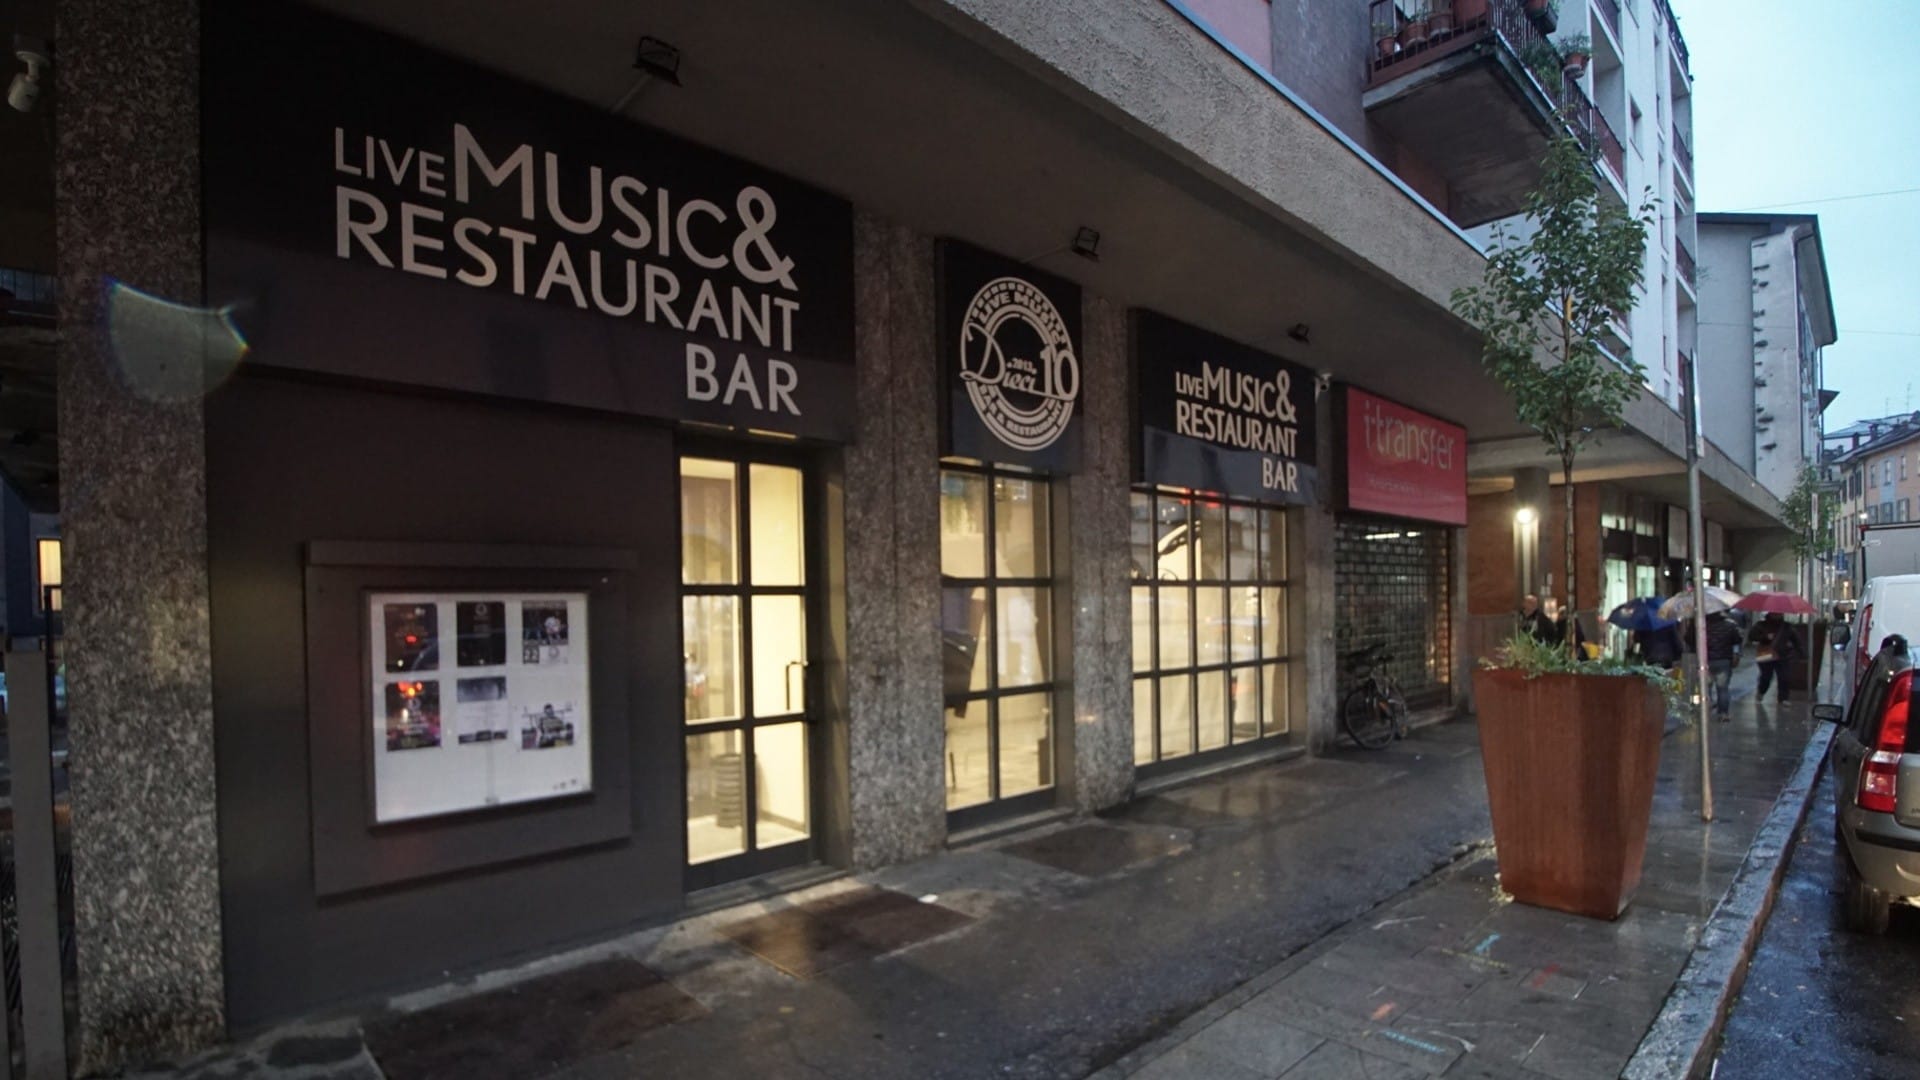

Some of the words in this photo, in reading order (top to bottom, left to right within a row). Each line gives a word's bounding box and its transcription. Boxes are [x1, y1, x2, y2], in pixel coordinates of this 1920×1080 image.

[335, 126, 447, 198] LIVE
[335, 185, 800, 352] RESTAURANT
[979, 291, 1011, 324] LIVE
[1013, 291, 1061, 345] MUSIC
[685, 342, 801, 416] BAR
[1175, 371, 1204, 400] LIVE
[1176, 399, 1298, 459] RESTAURANT
[1262, 457, 1298, 493] BAR
